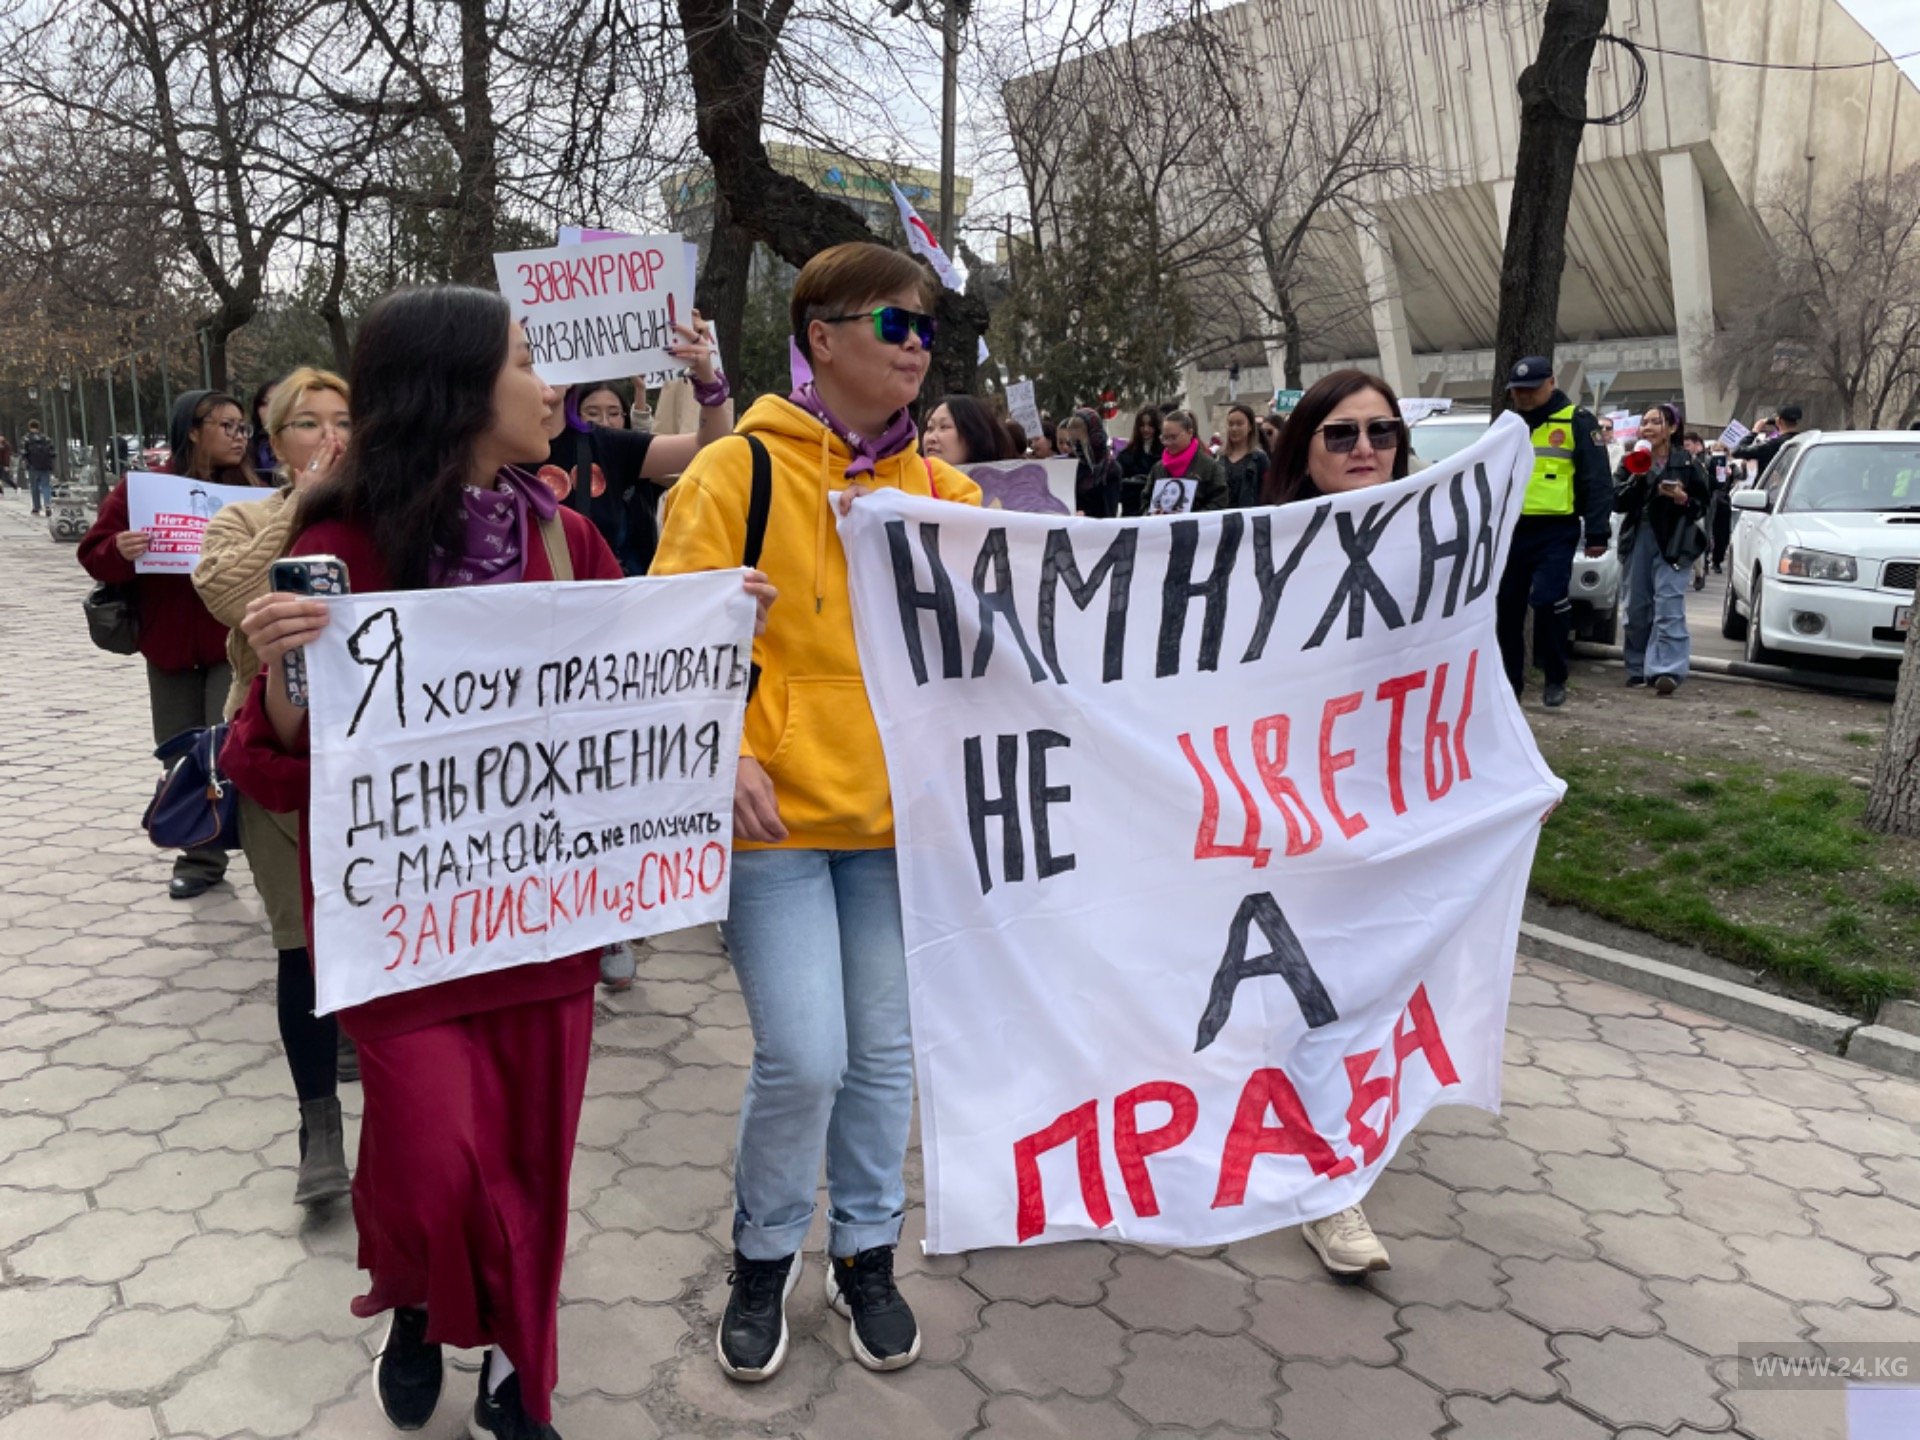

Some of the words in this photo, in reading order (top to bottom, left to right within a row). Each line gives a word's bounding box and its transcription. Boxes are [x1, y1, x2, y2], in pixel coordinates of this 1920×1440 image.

[884, 520, 1138, 685] НАМ
[1155, 461, 1519, 680] НУЖНЫ
[347, 607, 406, 738] Я
[538, 643, 748, 707] ПРАЗДНОВАТЬ
[346, 756, 468, 847] ДЕНЬ
[476, 720, 720, 813] РОЖДЕНИЯ
[963, 729, 1076, 895] НЕ
[1177, 649, 1480, 869] ЦВЕТЫ
[343, 857, 374, 907] С
[382, 866, 598, 971] ЗАПИСКИ
[1194, 891, 1338, 1053] А
